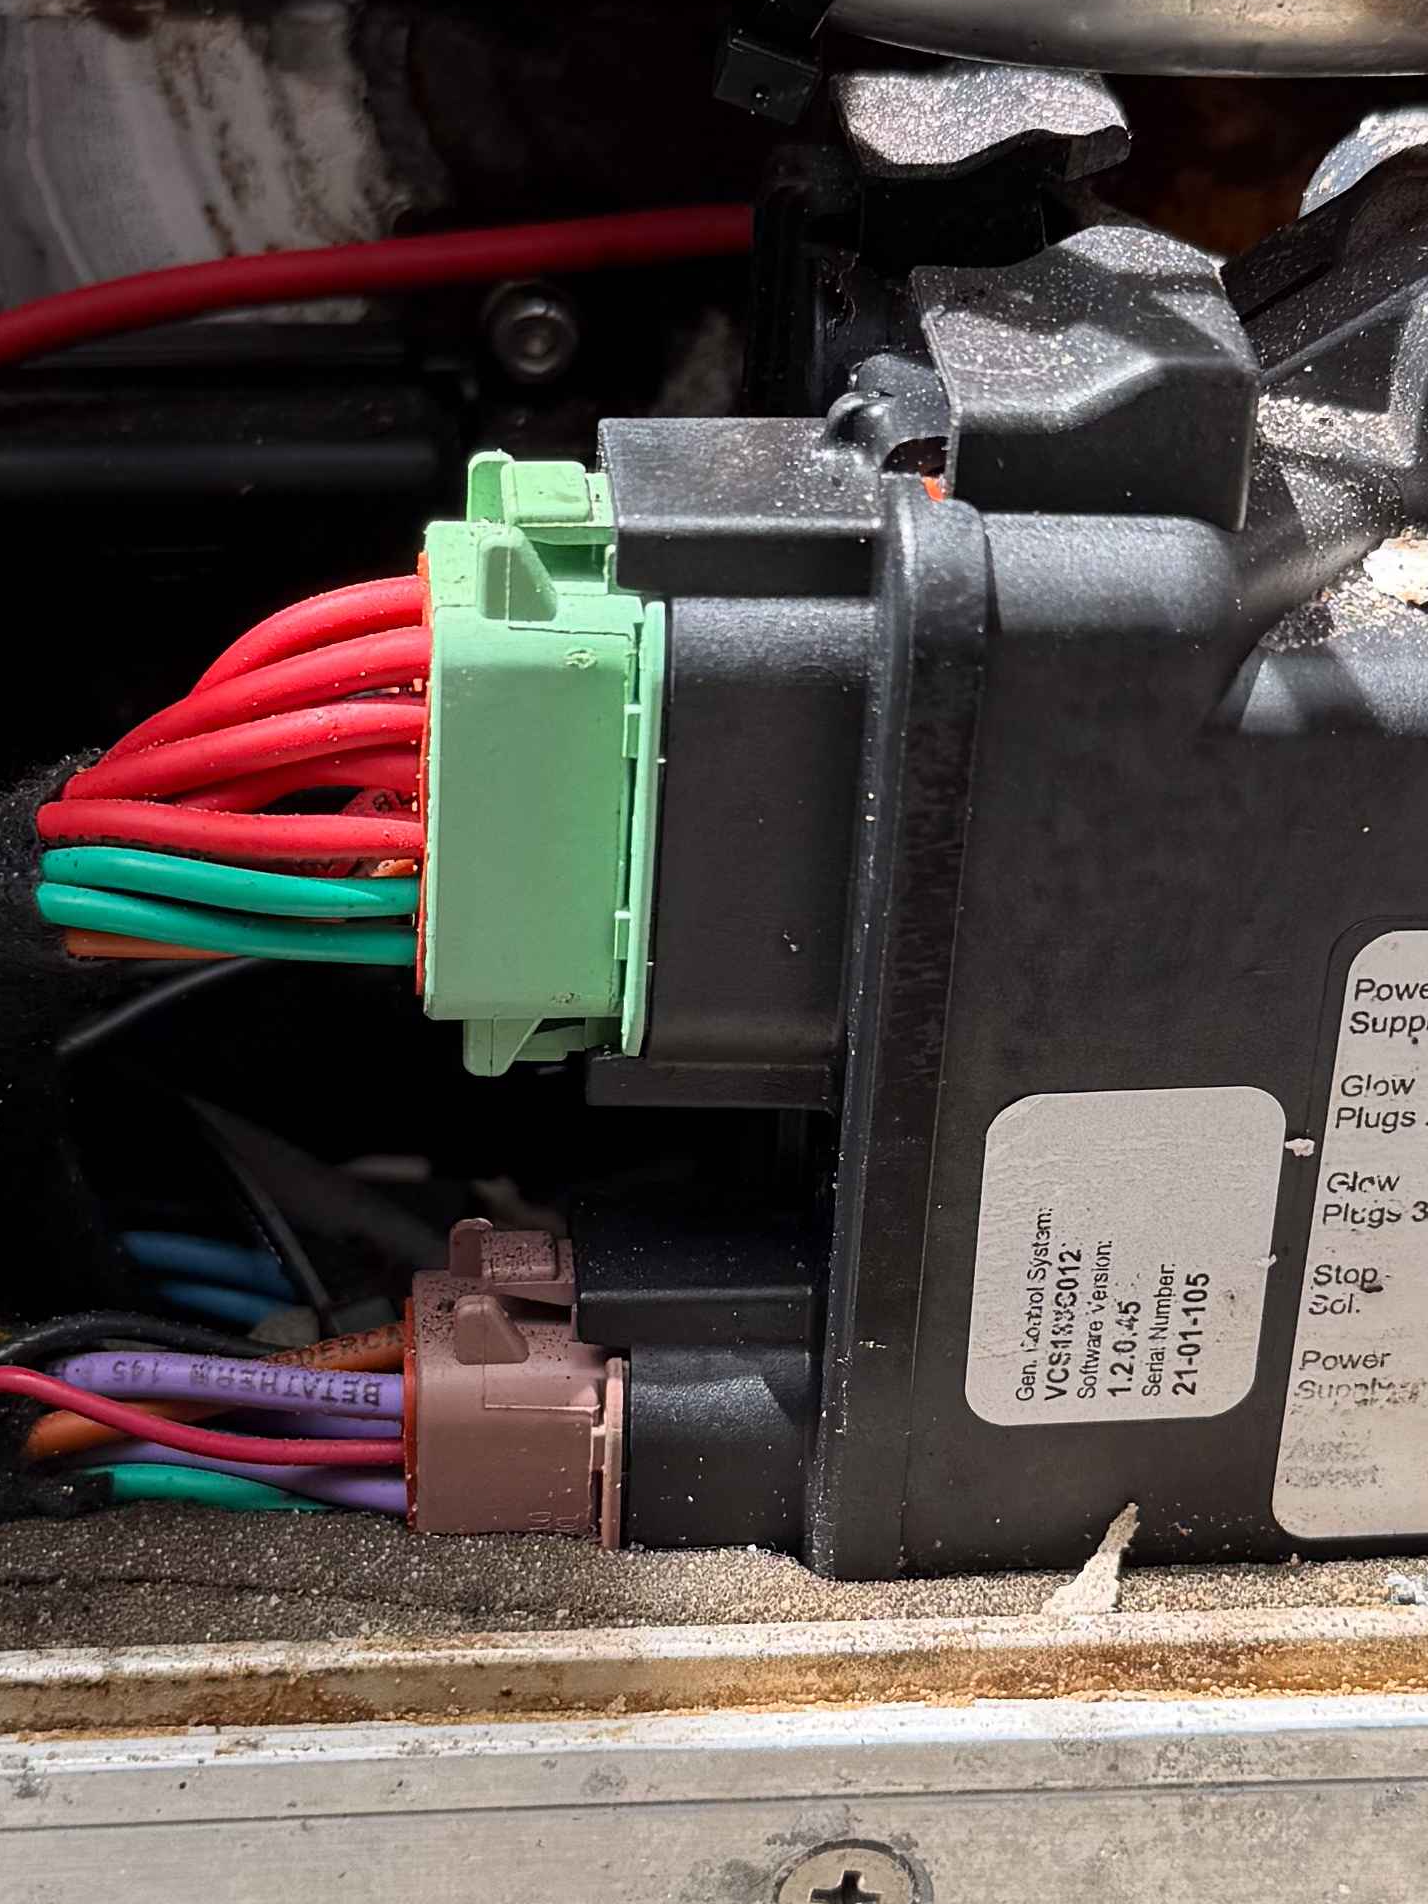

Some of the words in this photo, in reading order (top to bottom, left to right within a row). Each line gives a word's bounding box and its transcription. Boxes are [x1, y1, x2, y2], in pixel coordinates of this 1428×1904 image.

[1341, 1075, 1416, 1097] Glow
[1335, 1106, 1417, 1134] Plugs
[1313, 1264, 1379, 1291] Stop
[1148, 1264, 1176, 1341] Number:
[1308, 1294, 1360, 1315] Sol.
[1173, 1273, 1211, 1396] 21-01-105
[1077, 1317, 1104, 1399] Software
[1141, 1346, 1166, 1397] Serial
[1300, 1350, 1392, 1371] Power
[189, 1362, 383, 1408] BETATHERM
[1016, 1360, 1038, 1402] Gen.
